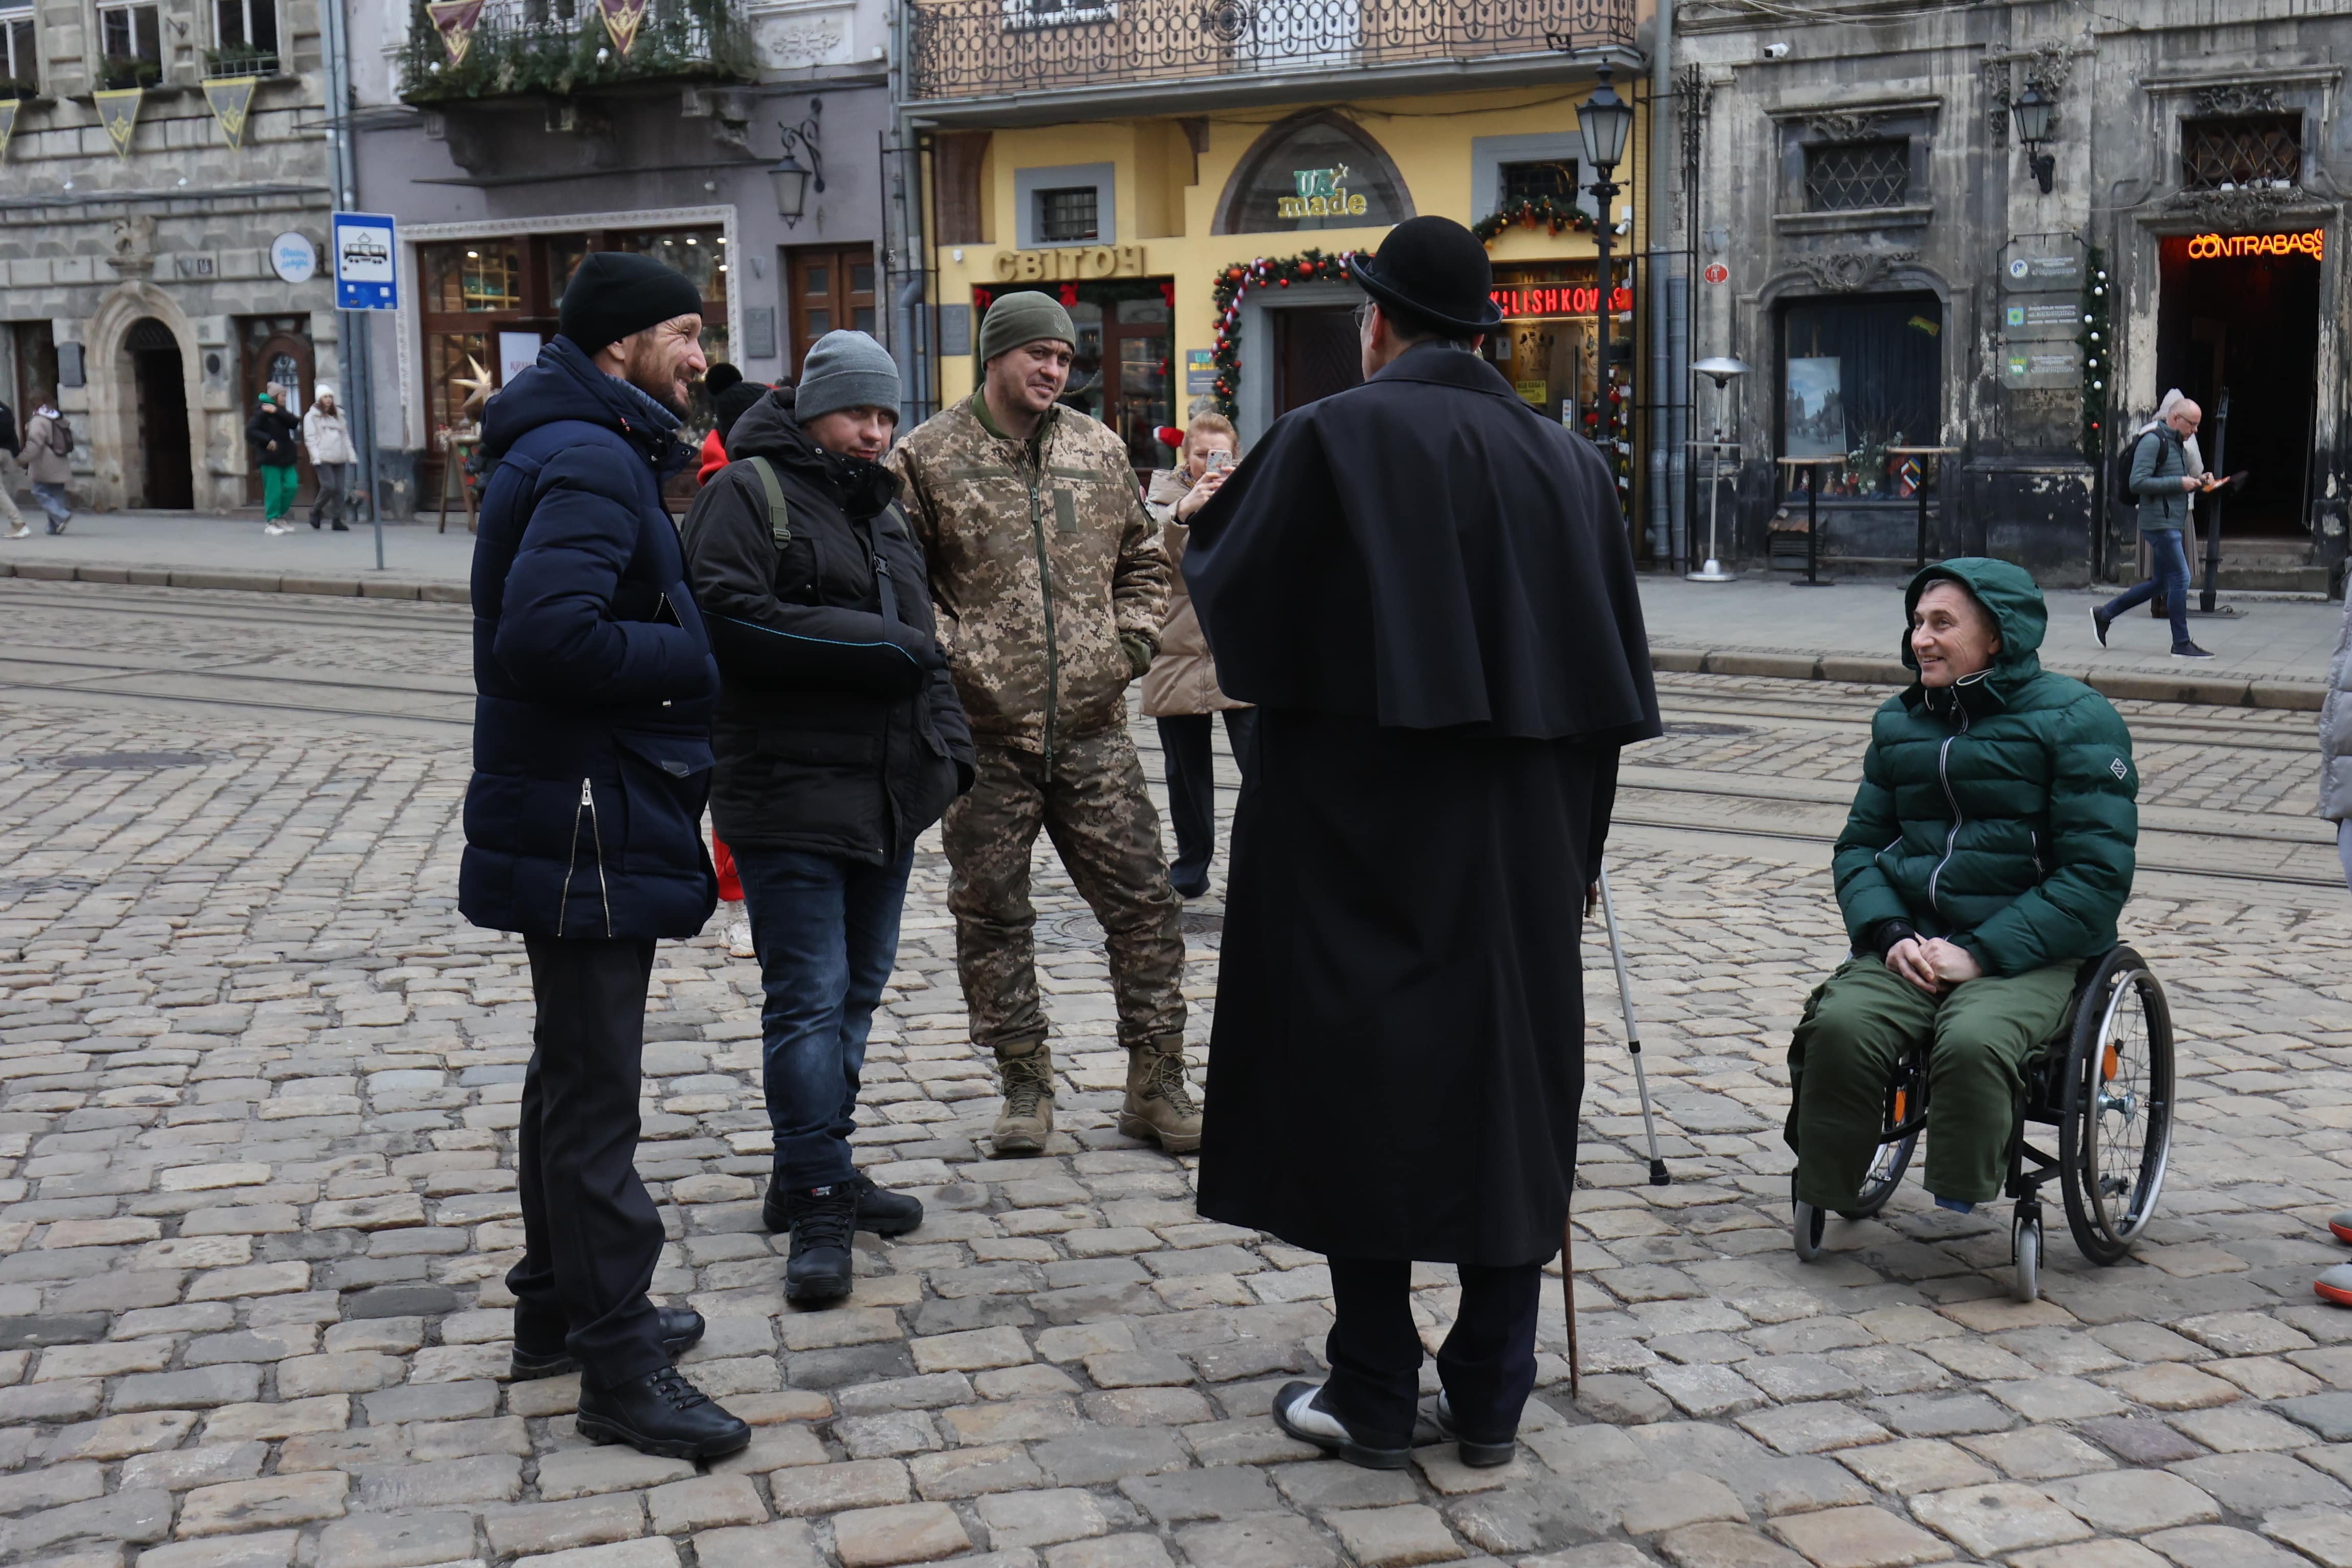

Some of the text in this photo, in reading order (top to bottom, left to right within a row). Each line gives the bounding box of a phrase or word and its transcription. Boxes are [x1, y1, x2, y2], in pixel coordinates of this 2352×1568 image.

[1294, 168, 1338, 197] UA
[1278, 187, 1367, 217] made
[993, 245, 1145, 280] СВІТОЧ
[1189, 360, 1216, 371] mad
